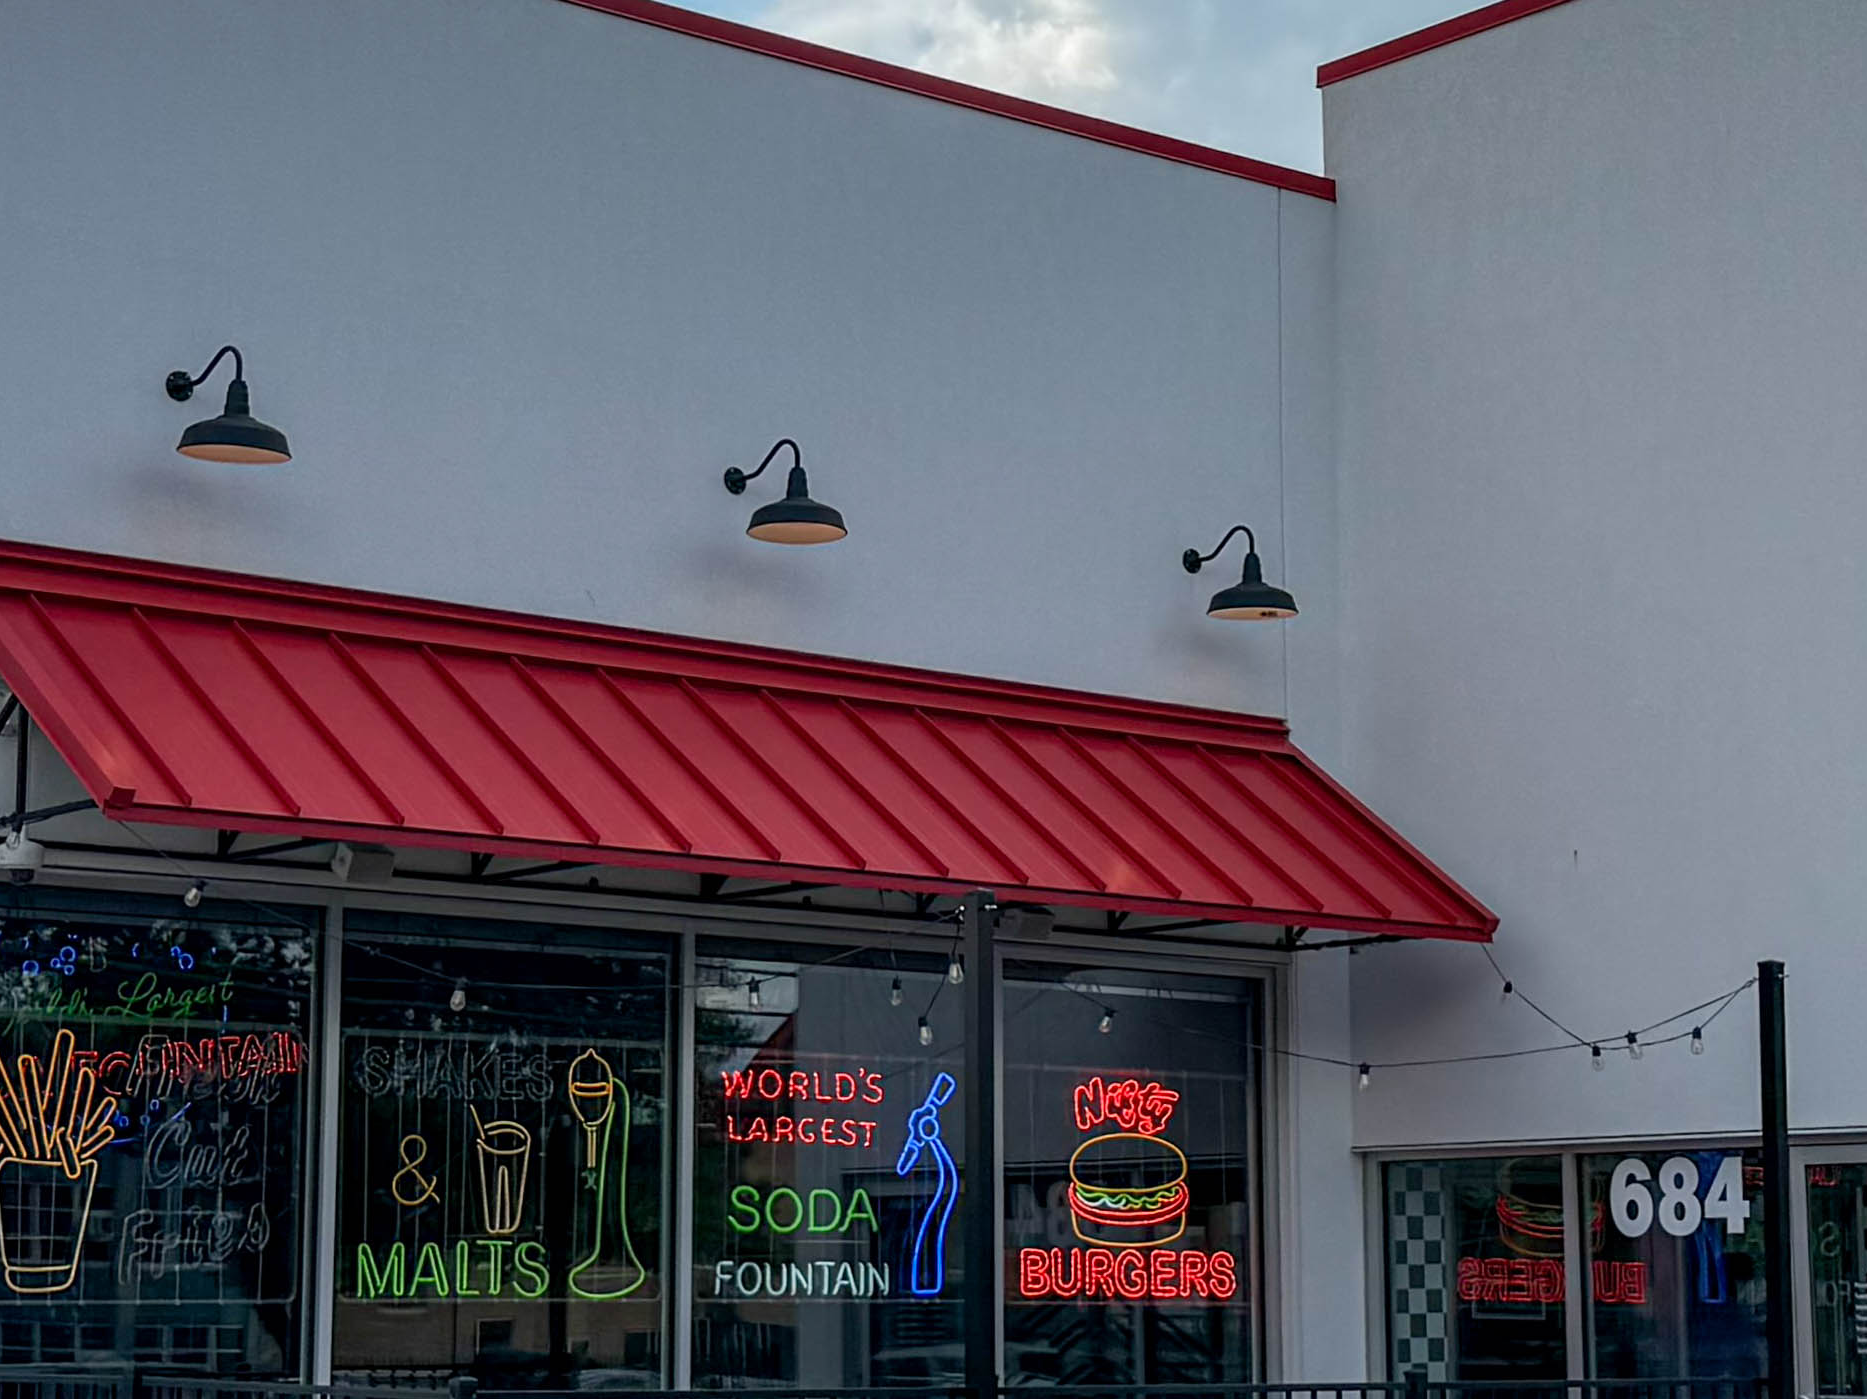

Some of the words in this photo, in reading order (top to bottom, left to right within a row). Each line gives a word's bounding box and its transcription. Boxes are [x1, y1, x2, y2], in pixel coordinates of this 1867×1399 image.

[361, 1045, 555, 1103] SHAKES
[721, 1067, 884, 1104] WORLD'S
[725, 1115, 878, 1149] LARGEST
[726, 1185, 879, 1234] SODA
[1610, 1156, 1751, 1238] 684
[356, 1239, 551, 1299] MALTS
[714, 1259, 891, 1298] FOUNTAIN
[1019, 1246, 1236, 1299] BURGERS
